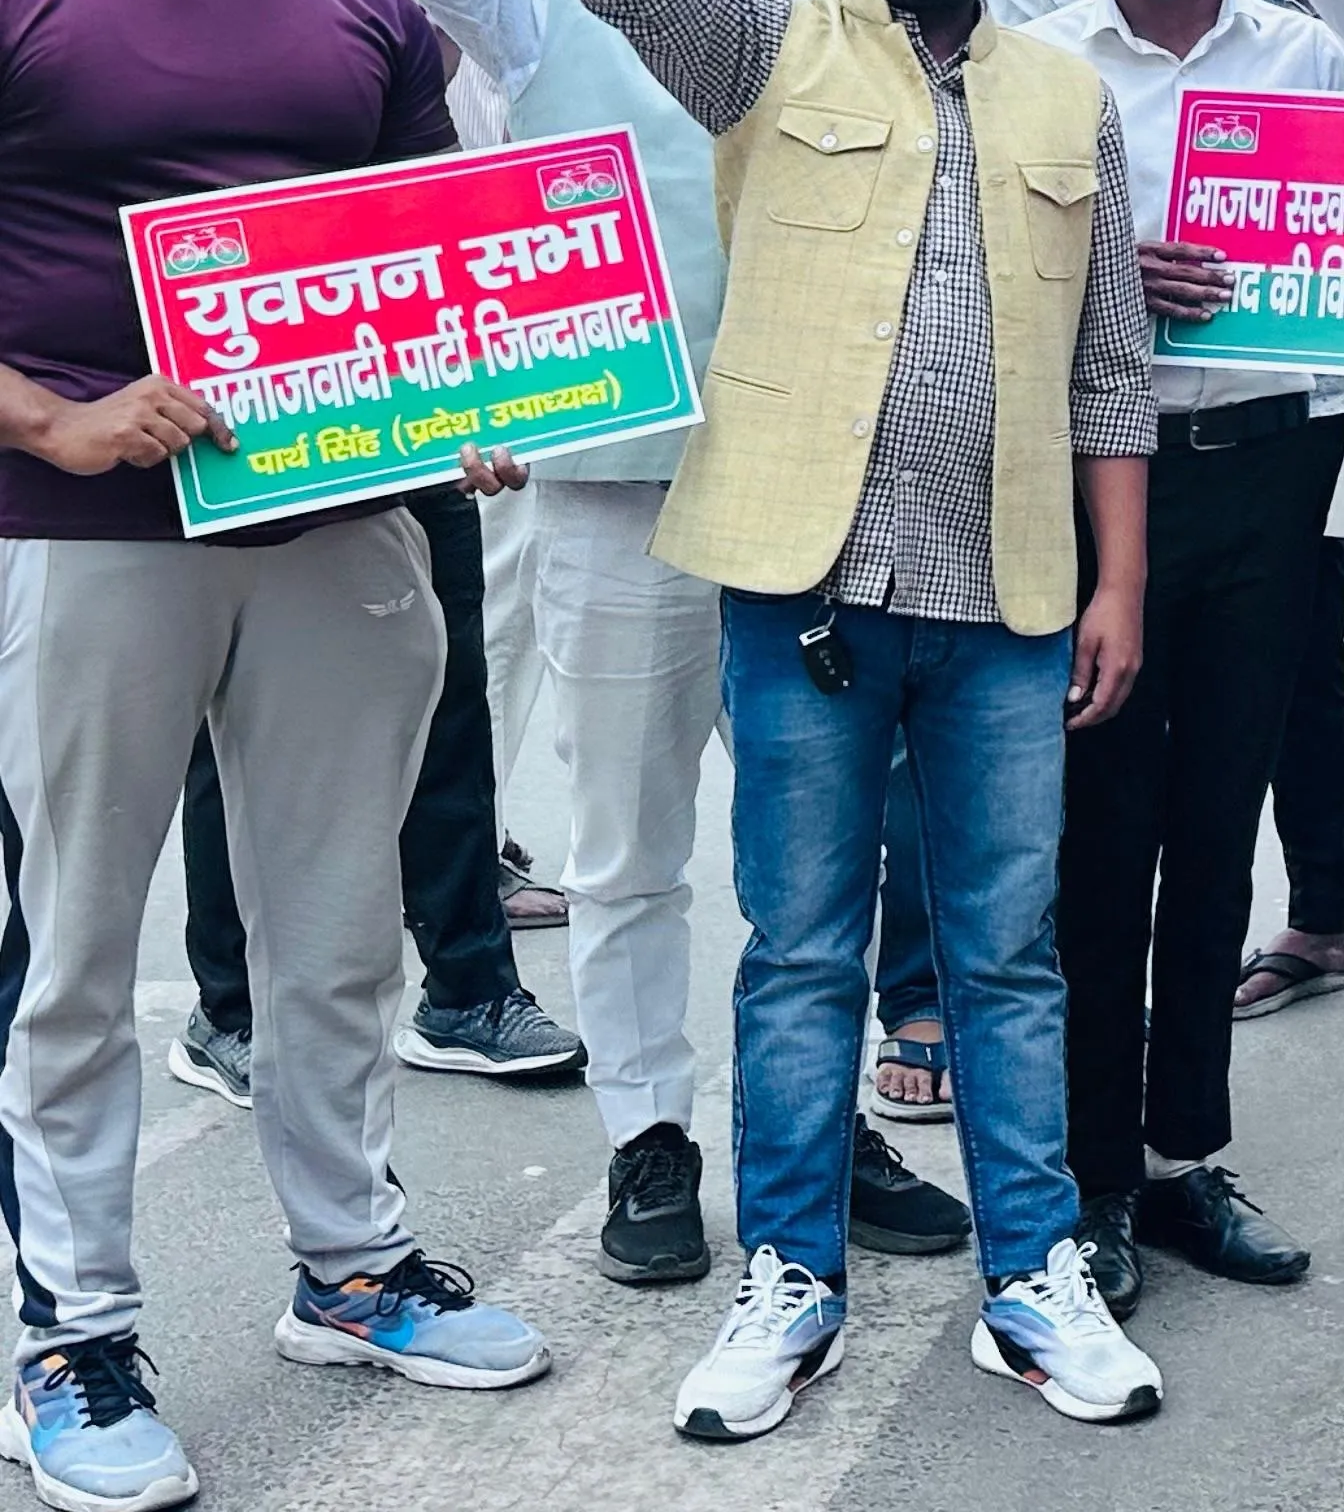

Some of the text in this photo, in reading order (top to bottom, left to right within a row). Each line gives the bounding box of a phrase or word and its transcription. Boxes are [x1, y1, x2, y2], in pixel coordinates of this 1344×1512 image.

[1184, 176, 1282, 232] भाजपा
[176, 210, 626, 371] युवजन सभा
[1269, 242, 1315, 318] की
[392, 292, 653, 394] पार्टी जिन्दाबाद
[246, 369, 624, 476] पार्थ सिंह (प्रदेश उपाध्यक्ष)
